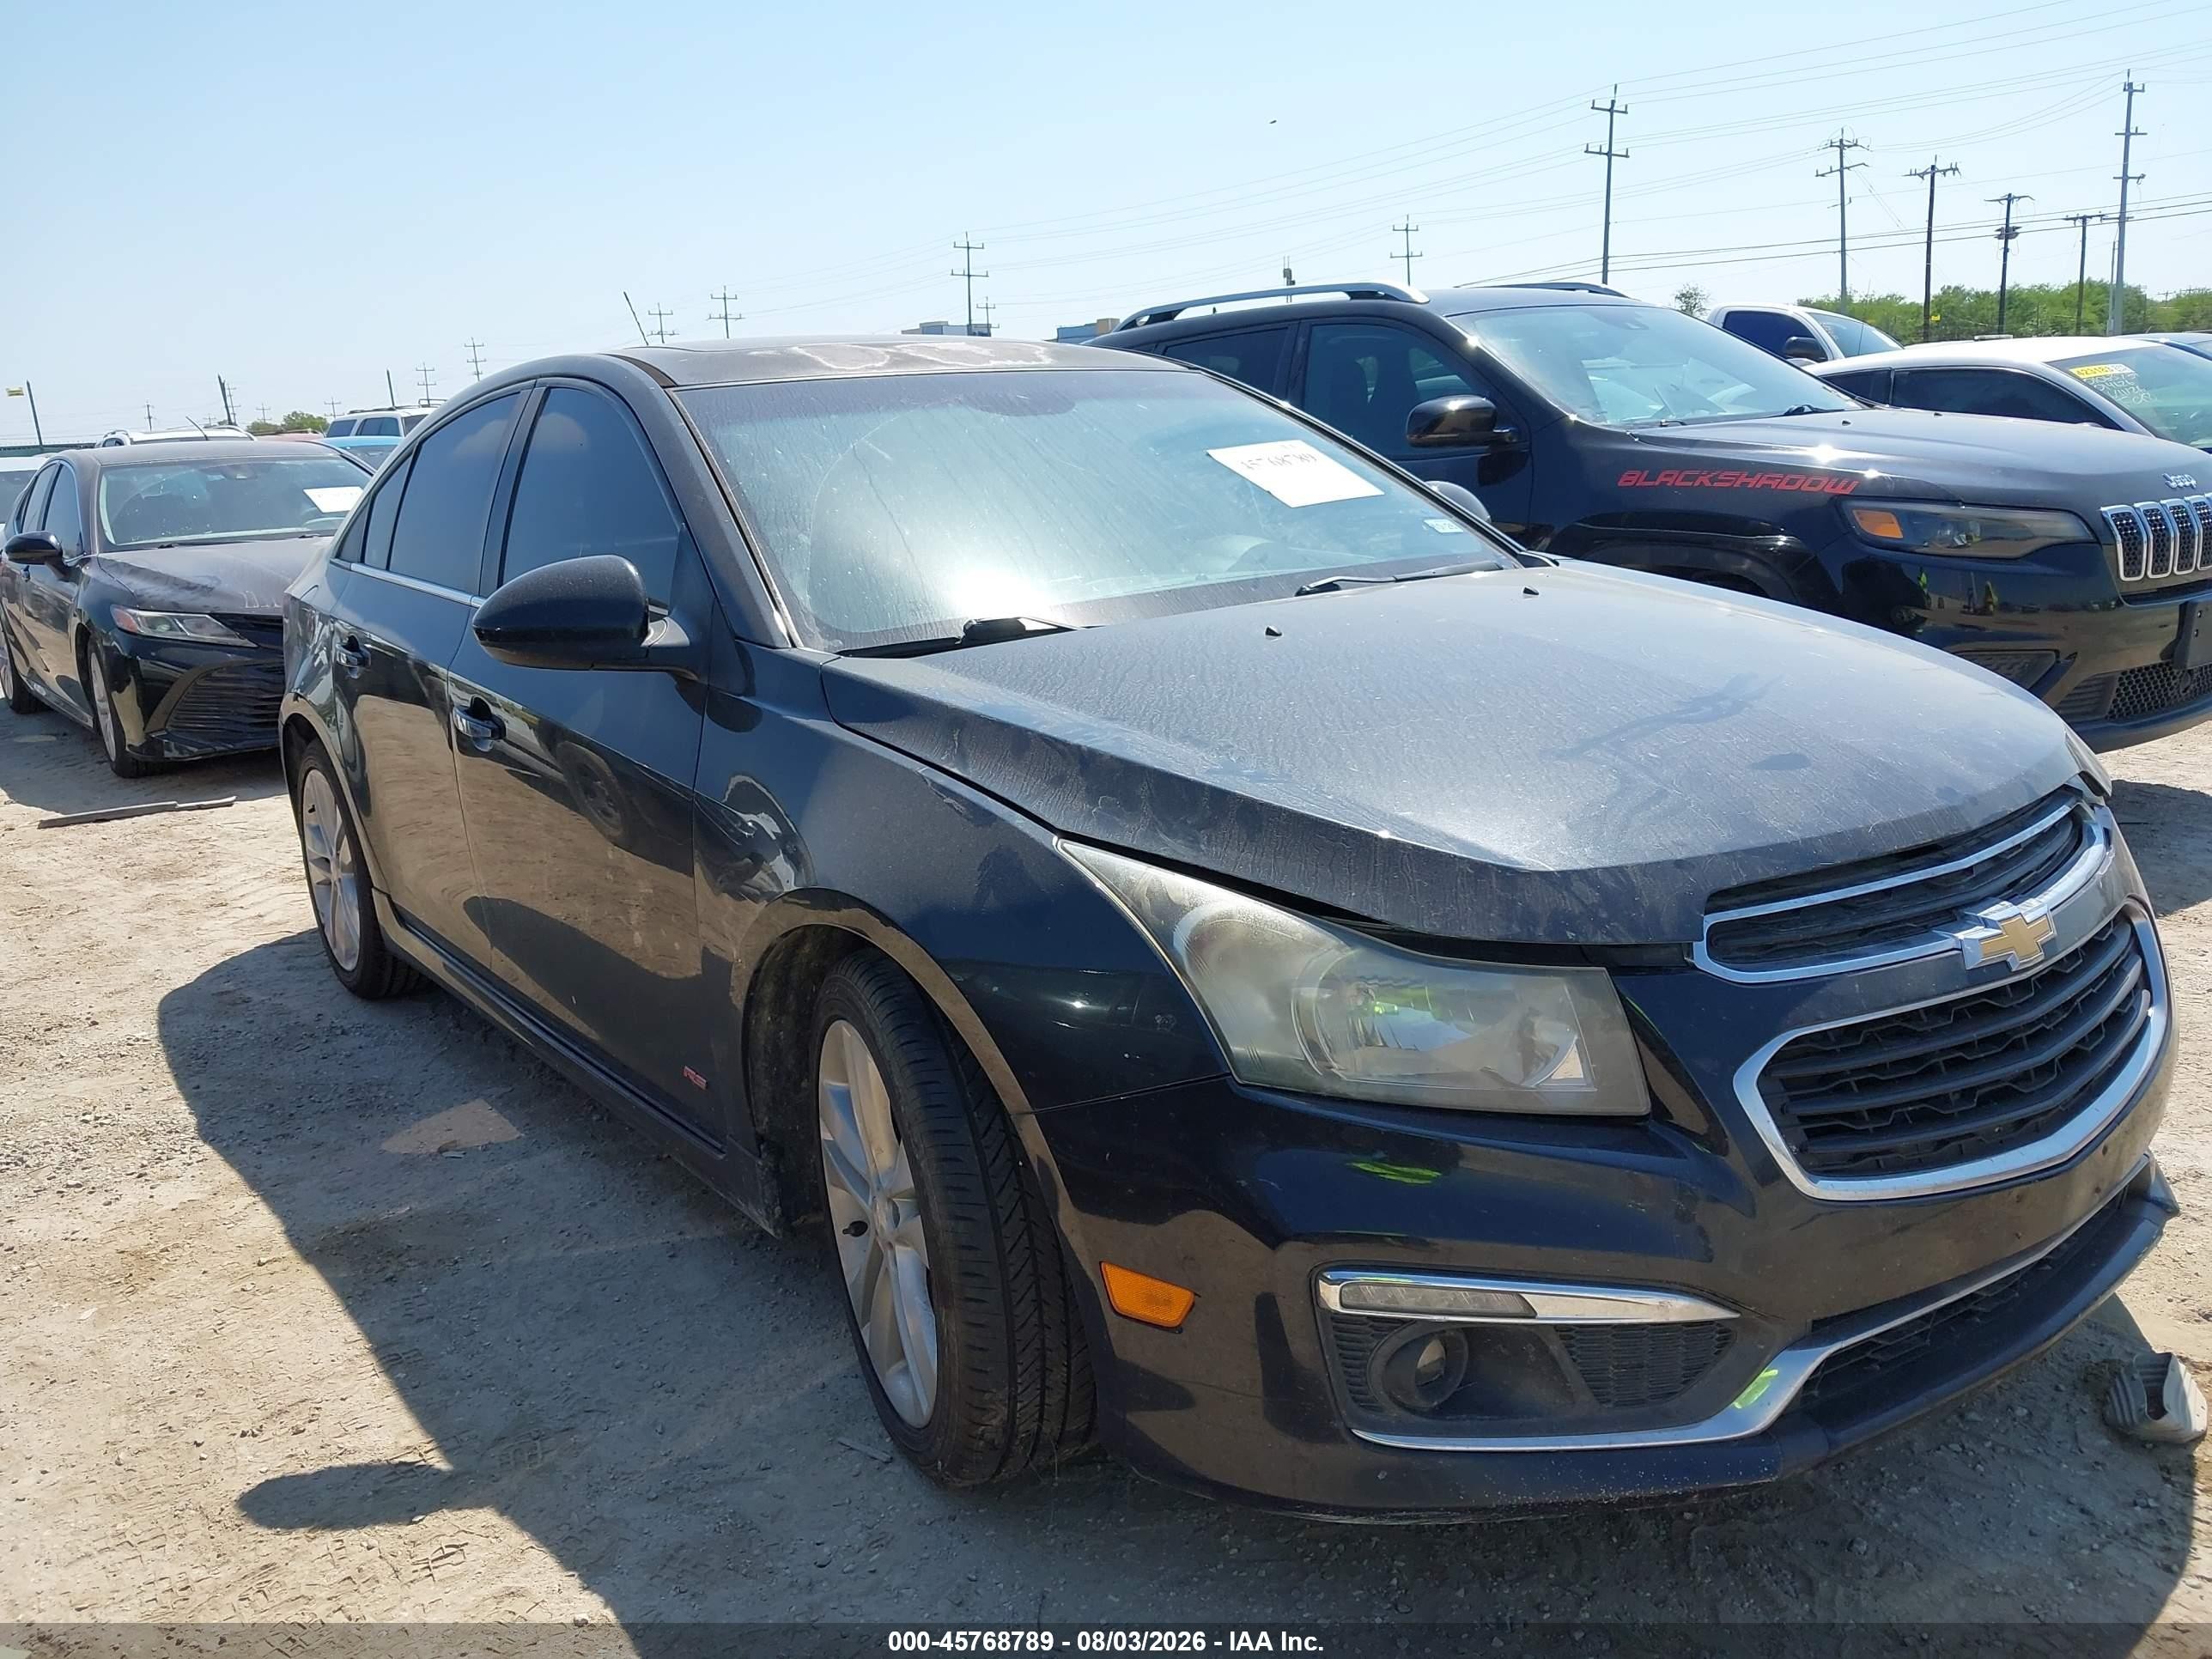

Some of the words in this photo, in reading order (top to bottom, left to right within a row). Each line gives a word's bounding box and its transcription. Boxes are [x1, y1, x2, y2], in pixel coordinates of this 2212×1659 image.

[1618, 469, 1860, 495] BLACKSHADOW
[2161, 472, 2197, 489] Jeep
[683, 1065, 708, 1091] RS
